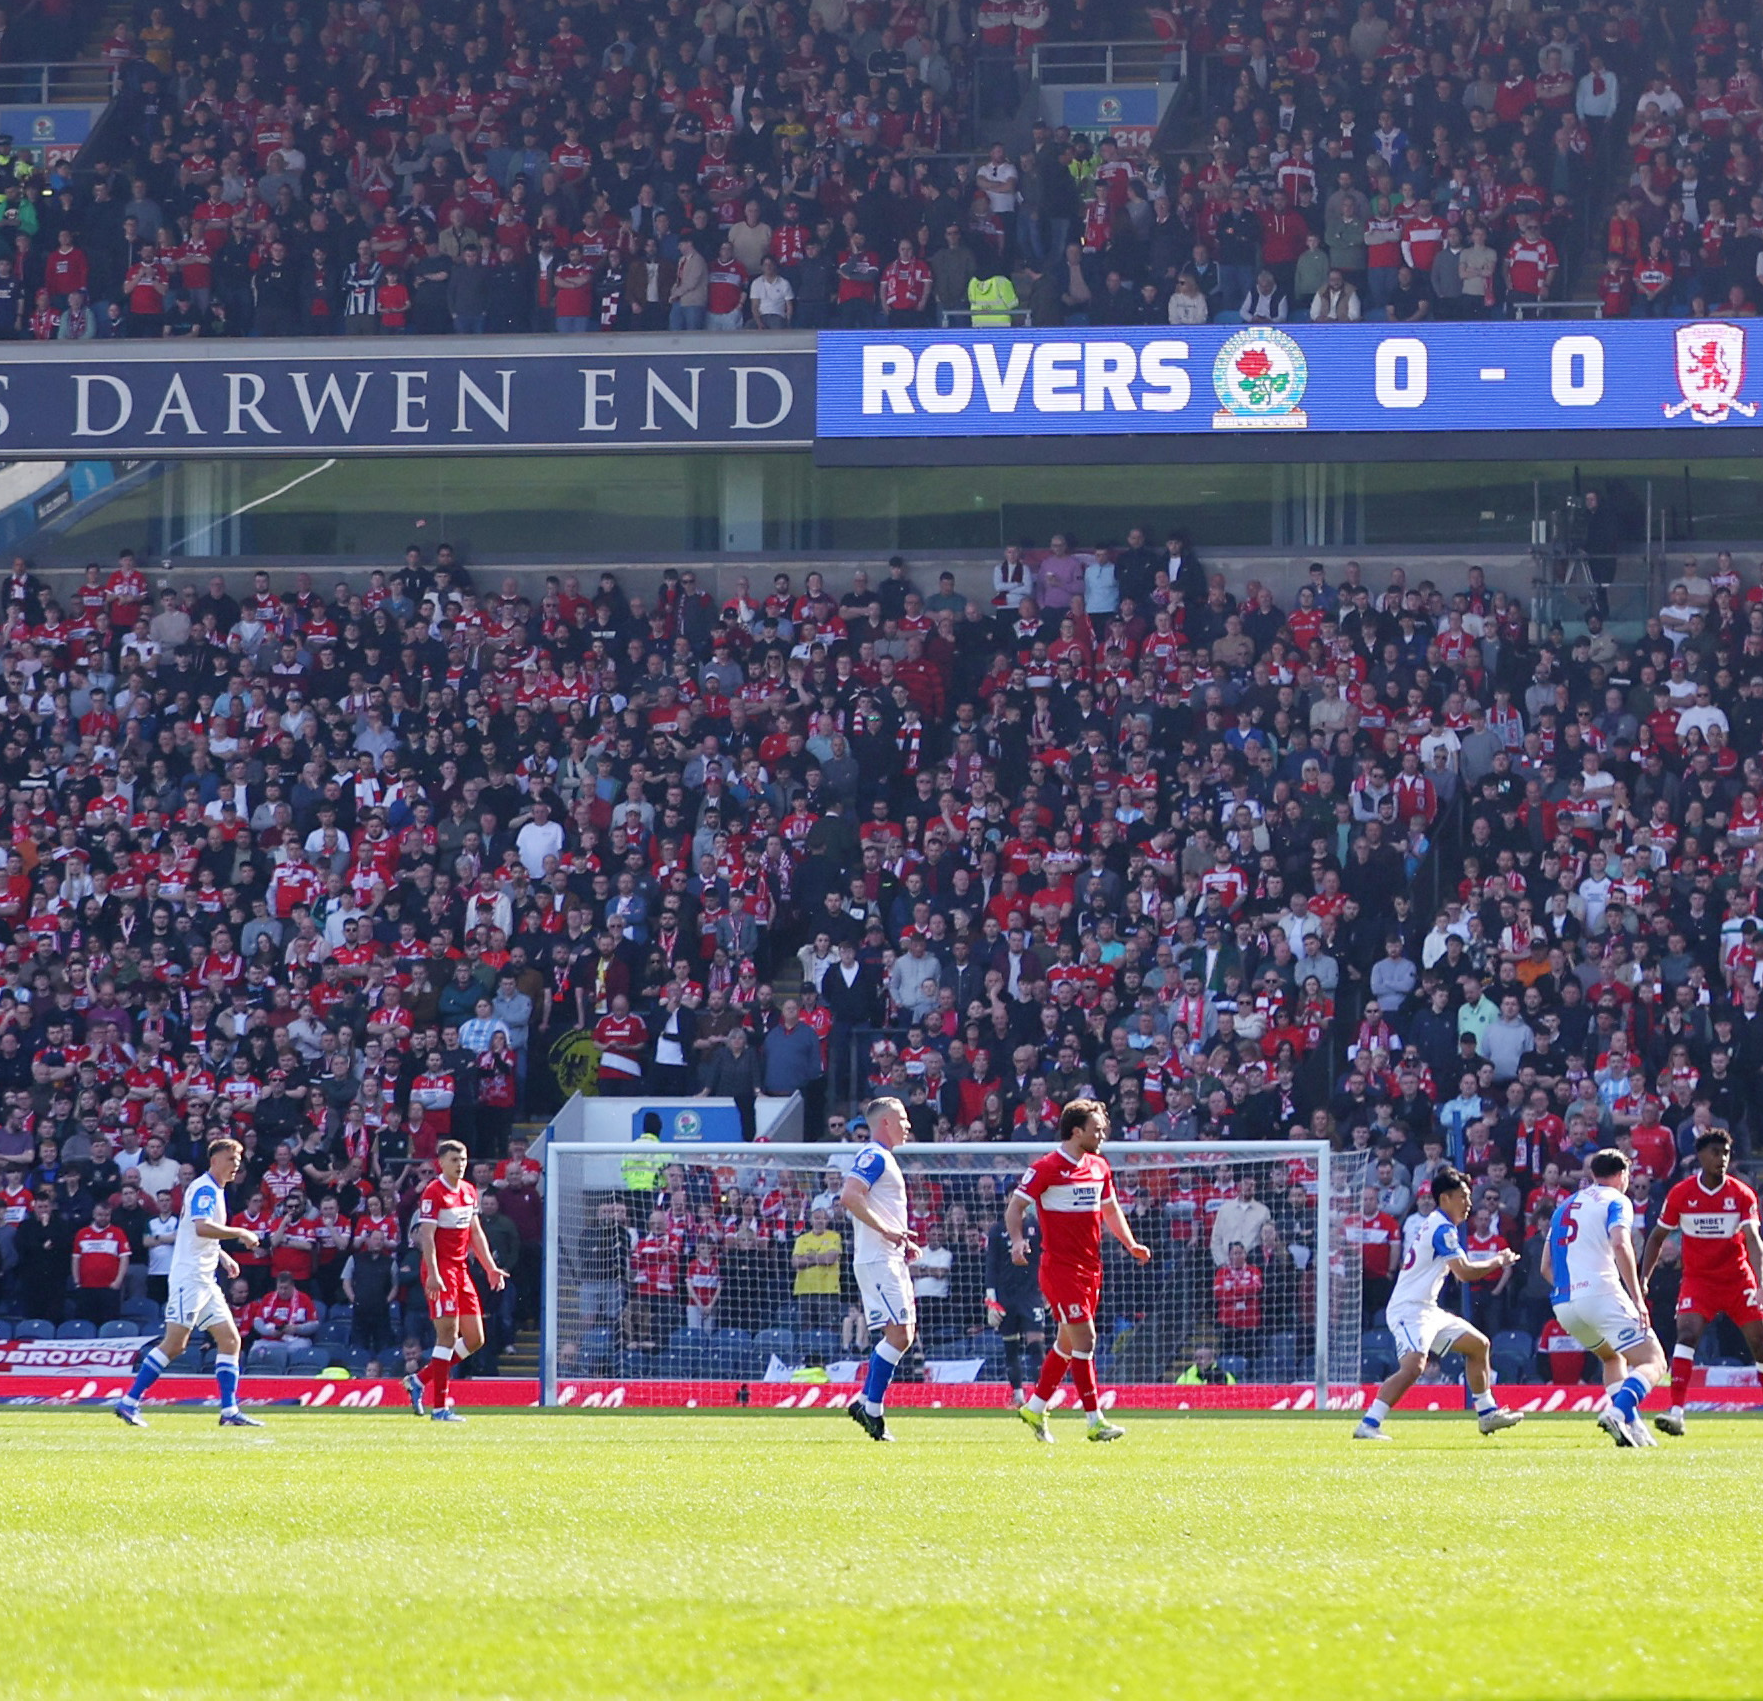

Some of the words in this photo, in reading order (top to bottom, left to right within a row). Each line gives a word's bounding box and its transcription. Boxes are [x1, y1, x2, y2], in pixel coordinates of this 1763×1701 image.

[1114, 130, 1152, 148] 214
[863, 341, 1191, 414] ROVERS
[1375, 338, 1428, 408] 0
[1480, 368, 1506, 380] -
[1551, 335, 1605, 407] 0
[70, 370, 517, 436] DARWEN
[578, 367, 794, 431] END
[1558, 1202, 1583, 1247] 5
[1694, 1217, 1725, 1225] UNIBET
